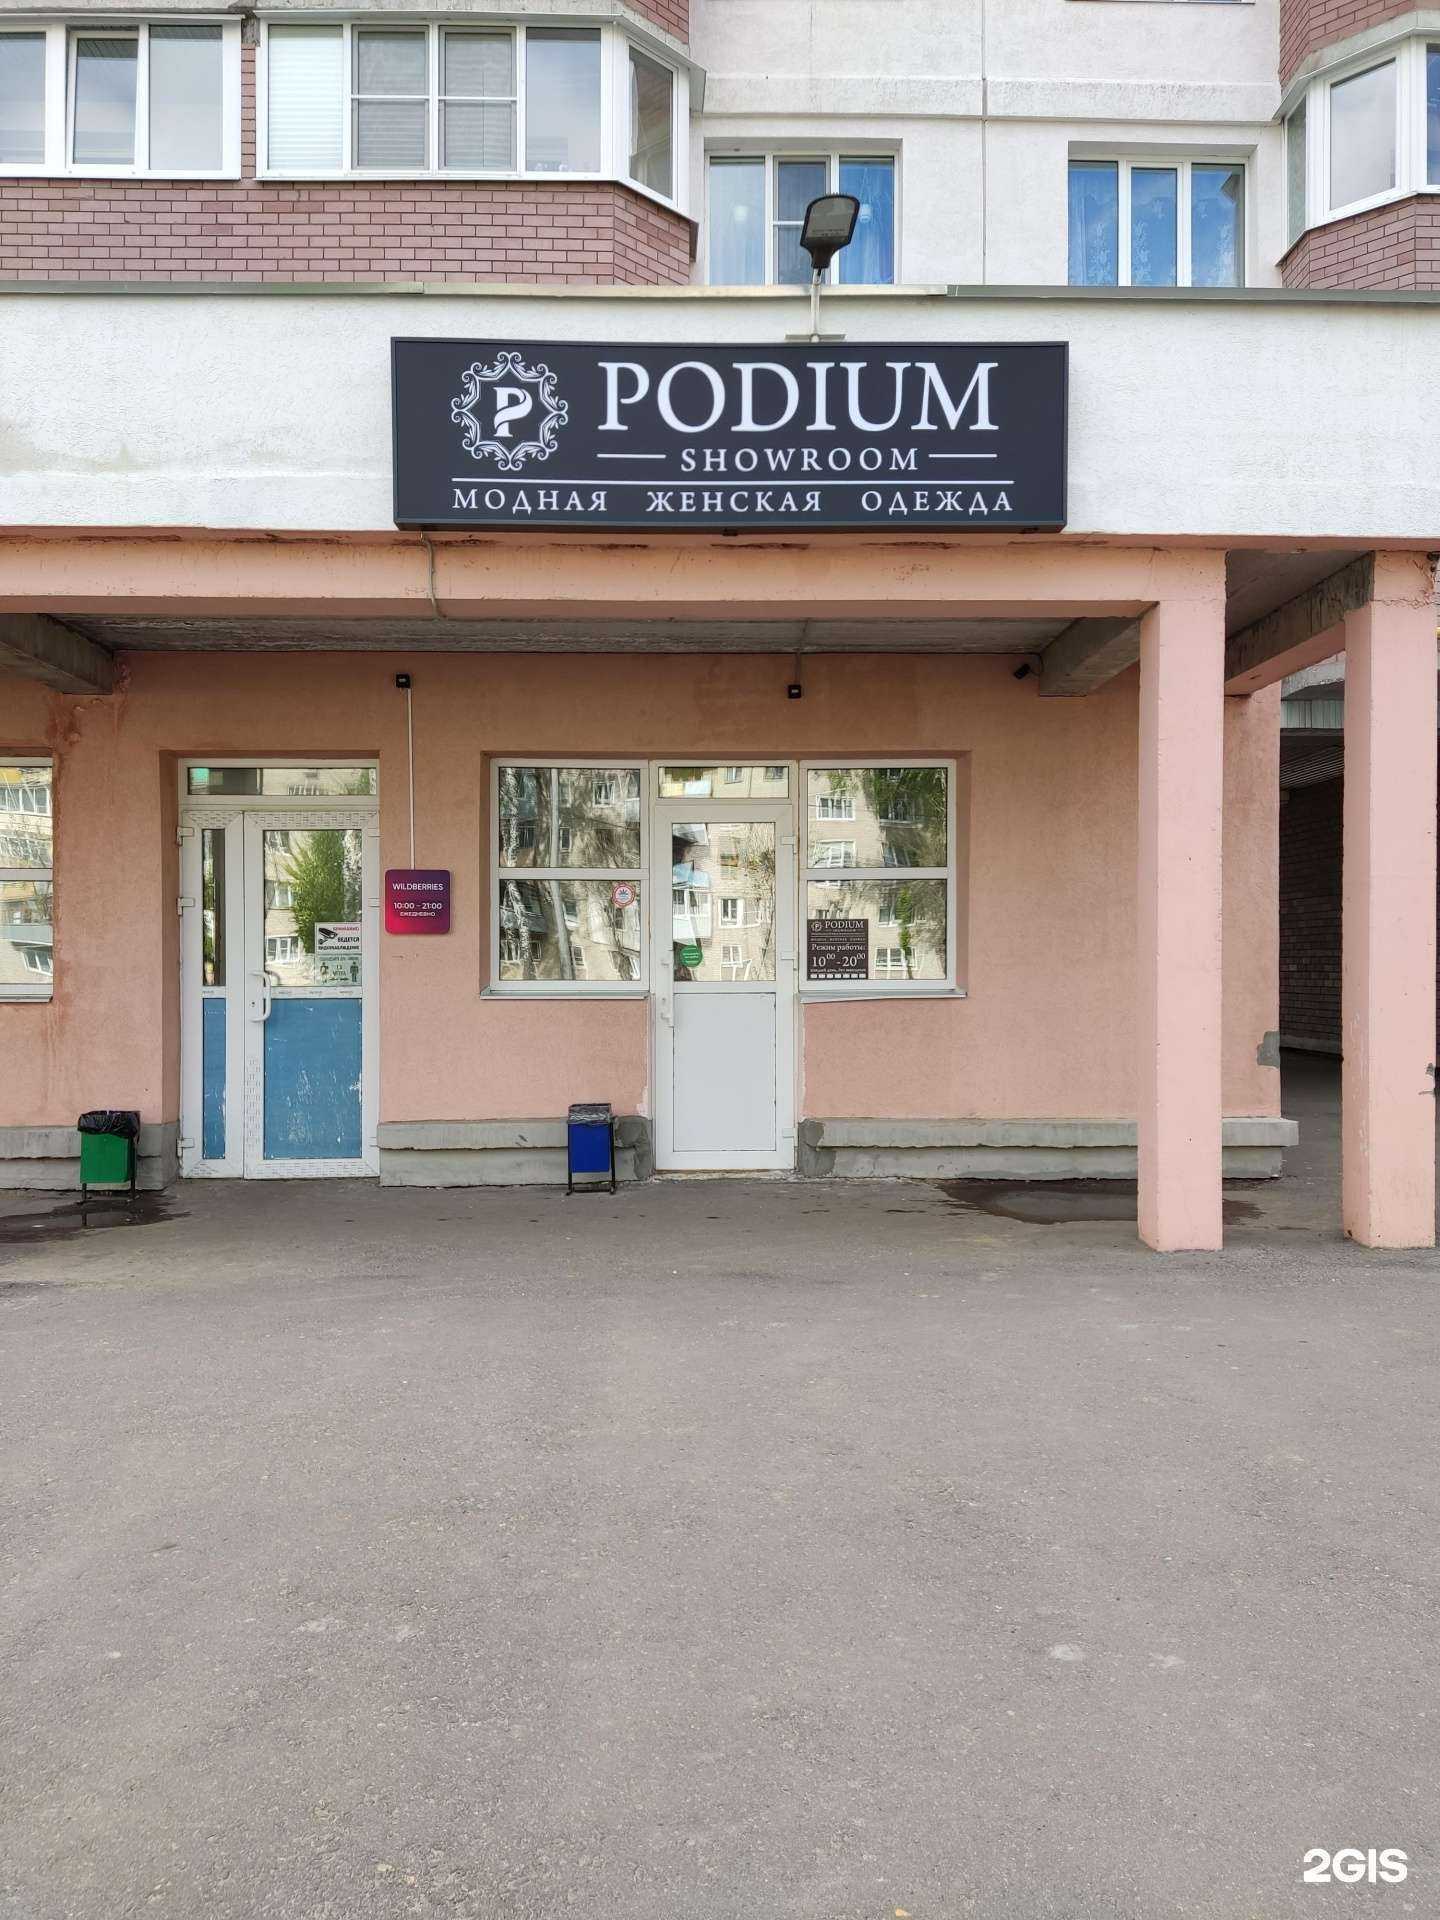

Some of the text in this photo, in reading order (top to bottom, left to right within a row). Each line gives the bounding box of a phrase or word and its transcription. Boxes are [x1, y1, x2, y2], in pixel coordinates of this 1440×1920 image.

[597, 361, 1000, 434] PODIUM
[680, 447, 919, 472] SHOWROOM
[452, 488, 1014, 516] МОДНАЯ ЖЕНСКАЯ ОДЕЖДА
[392, 883, 444, 891] WILDBERRIES
[393, 902, 415, 910] 10:00
[422, 902, 442, 910] 21:00
[825, 920, 865, 929] PODIUM
